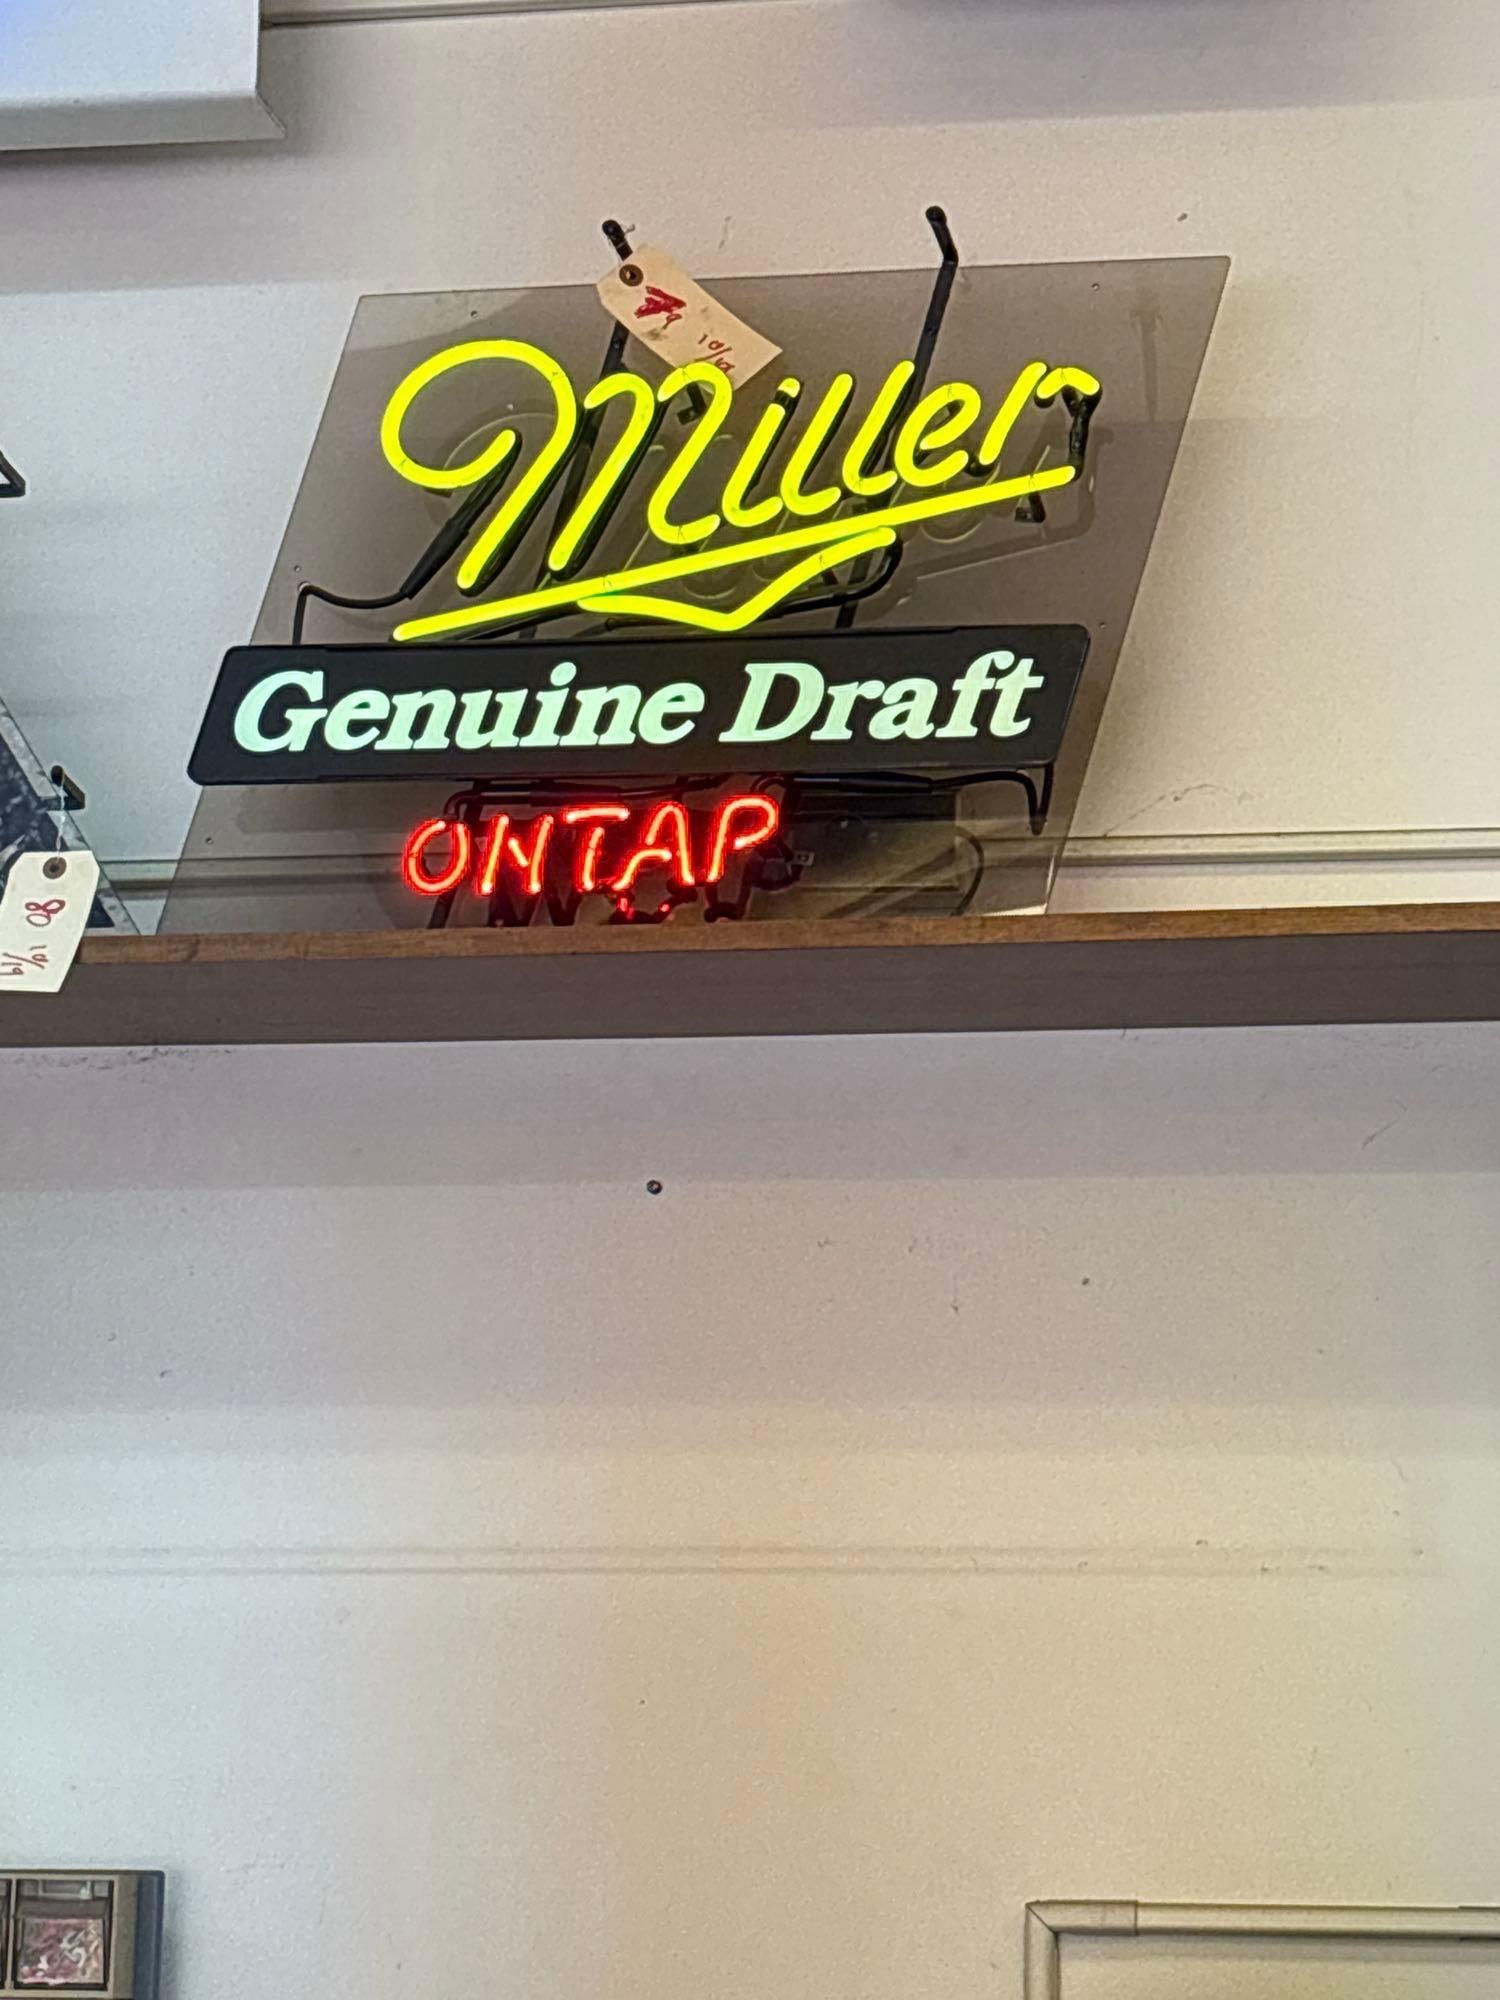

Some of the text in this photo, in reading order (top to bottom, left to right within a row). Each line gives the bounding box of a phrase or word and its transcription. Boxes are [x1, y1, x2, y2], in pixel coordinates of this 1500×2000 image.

[380, 338, 1101, 590] Miller
[231, 650, 1045, 754] Genuine Draft
